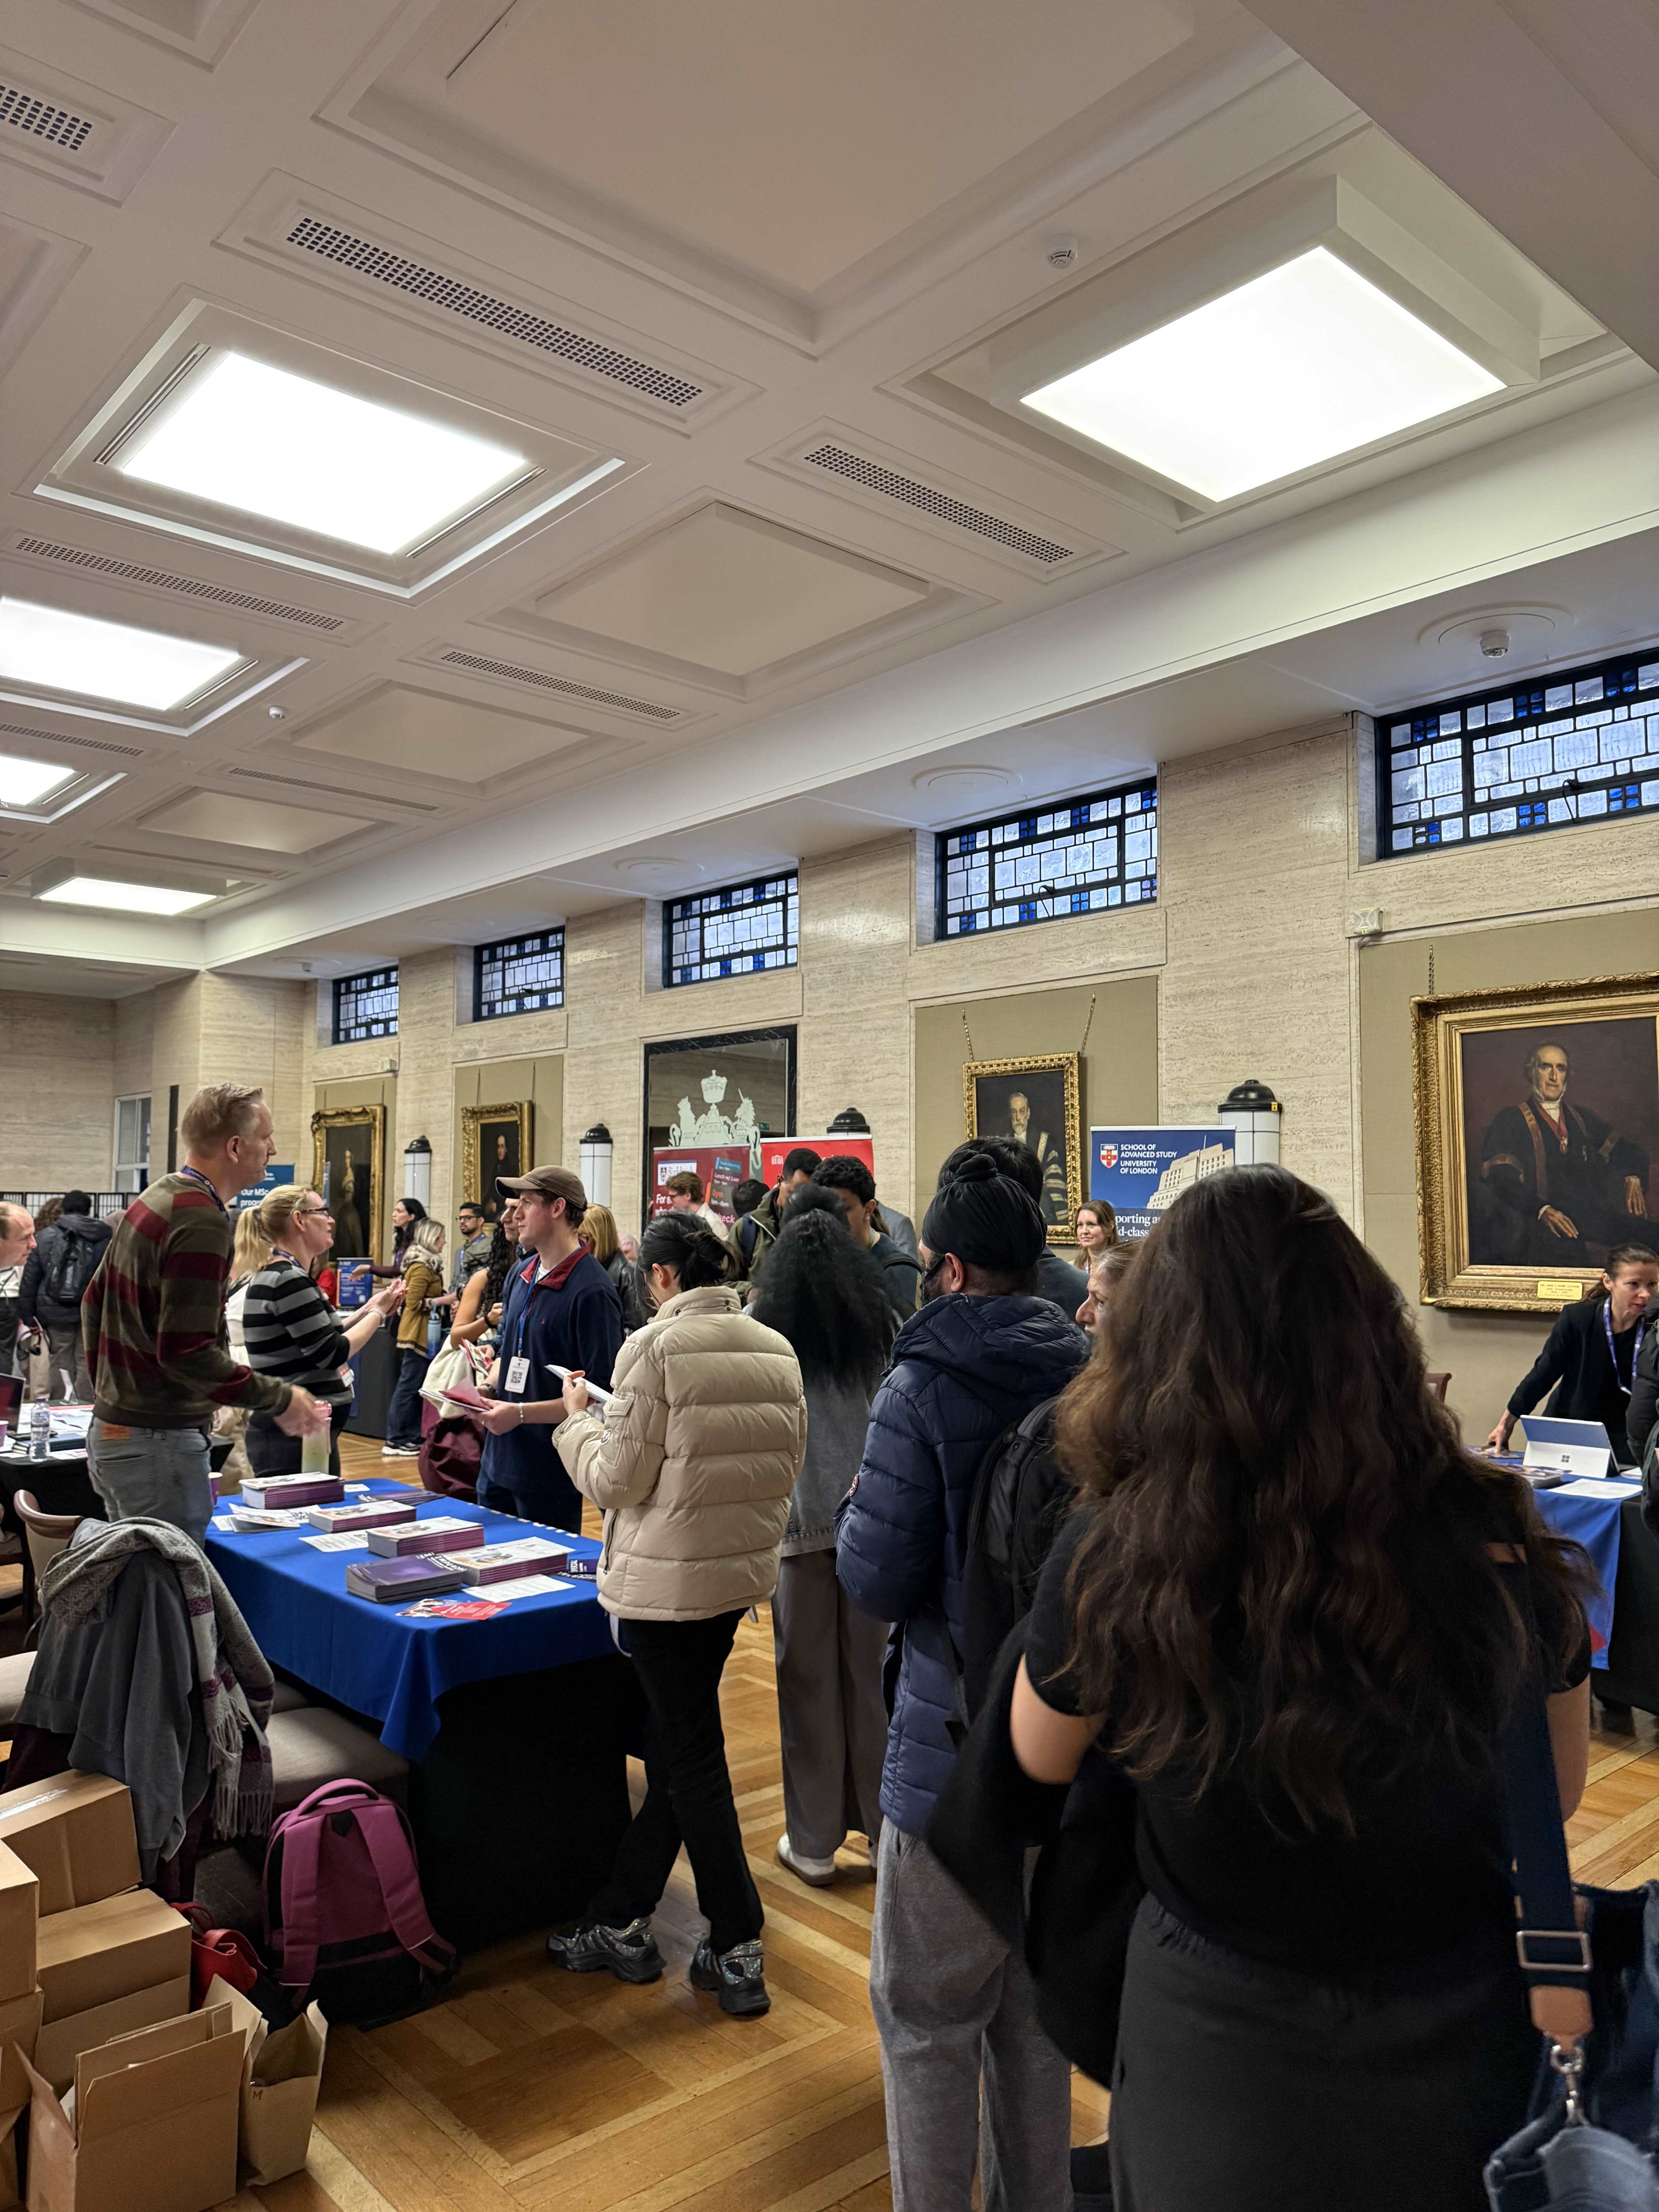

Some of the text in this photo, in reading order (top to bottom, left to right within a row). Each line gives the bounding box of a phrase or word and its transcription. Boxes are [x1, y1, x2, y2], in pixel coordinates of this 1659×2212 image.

[656, 1194, 666, 1204] For
[1115, 1214, 1151, 1227] porting
[1118, 1226, 1149, 1237] d-class
